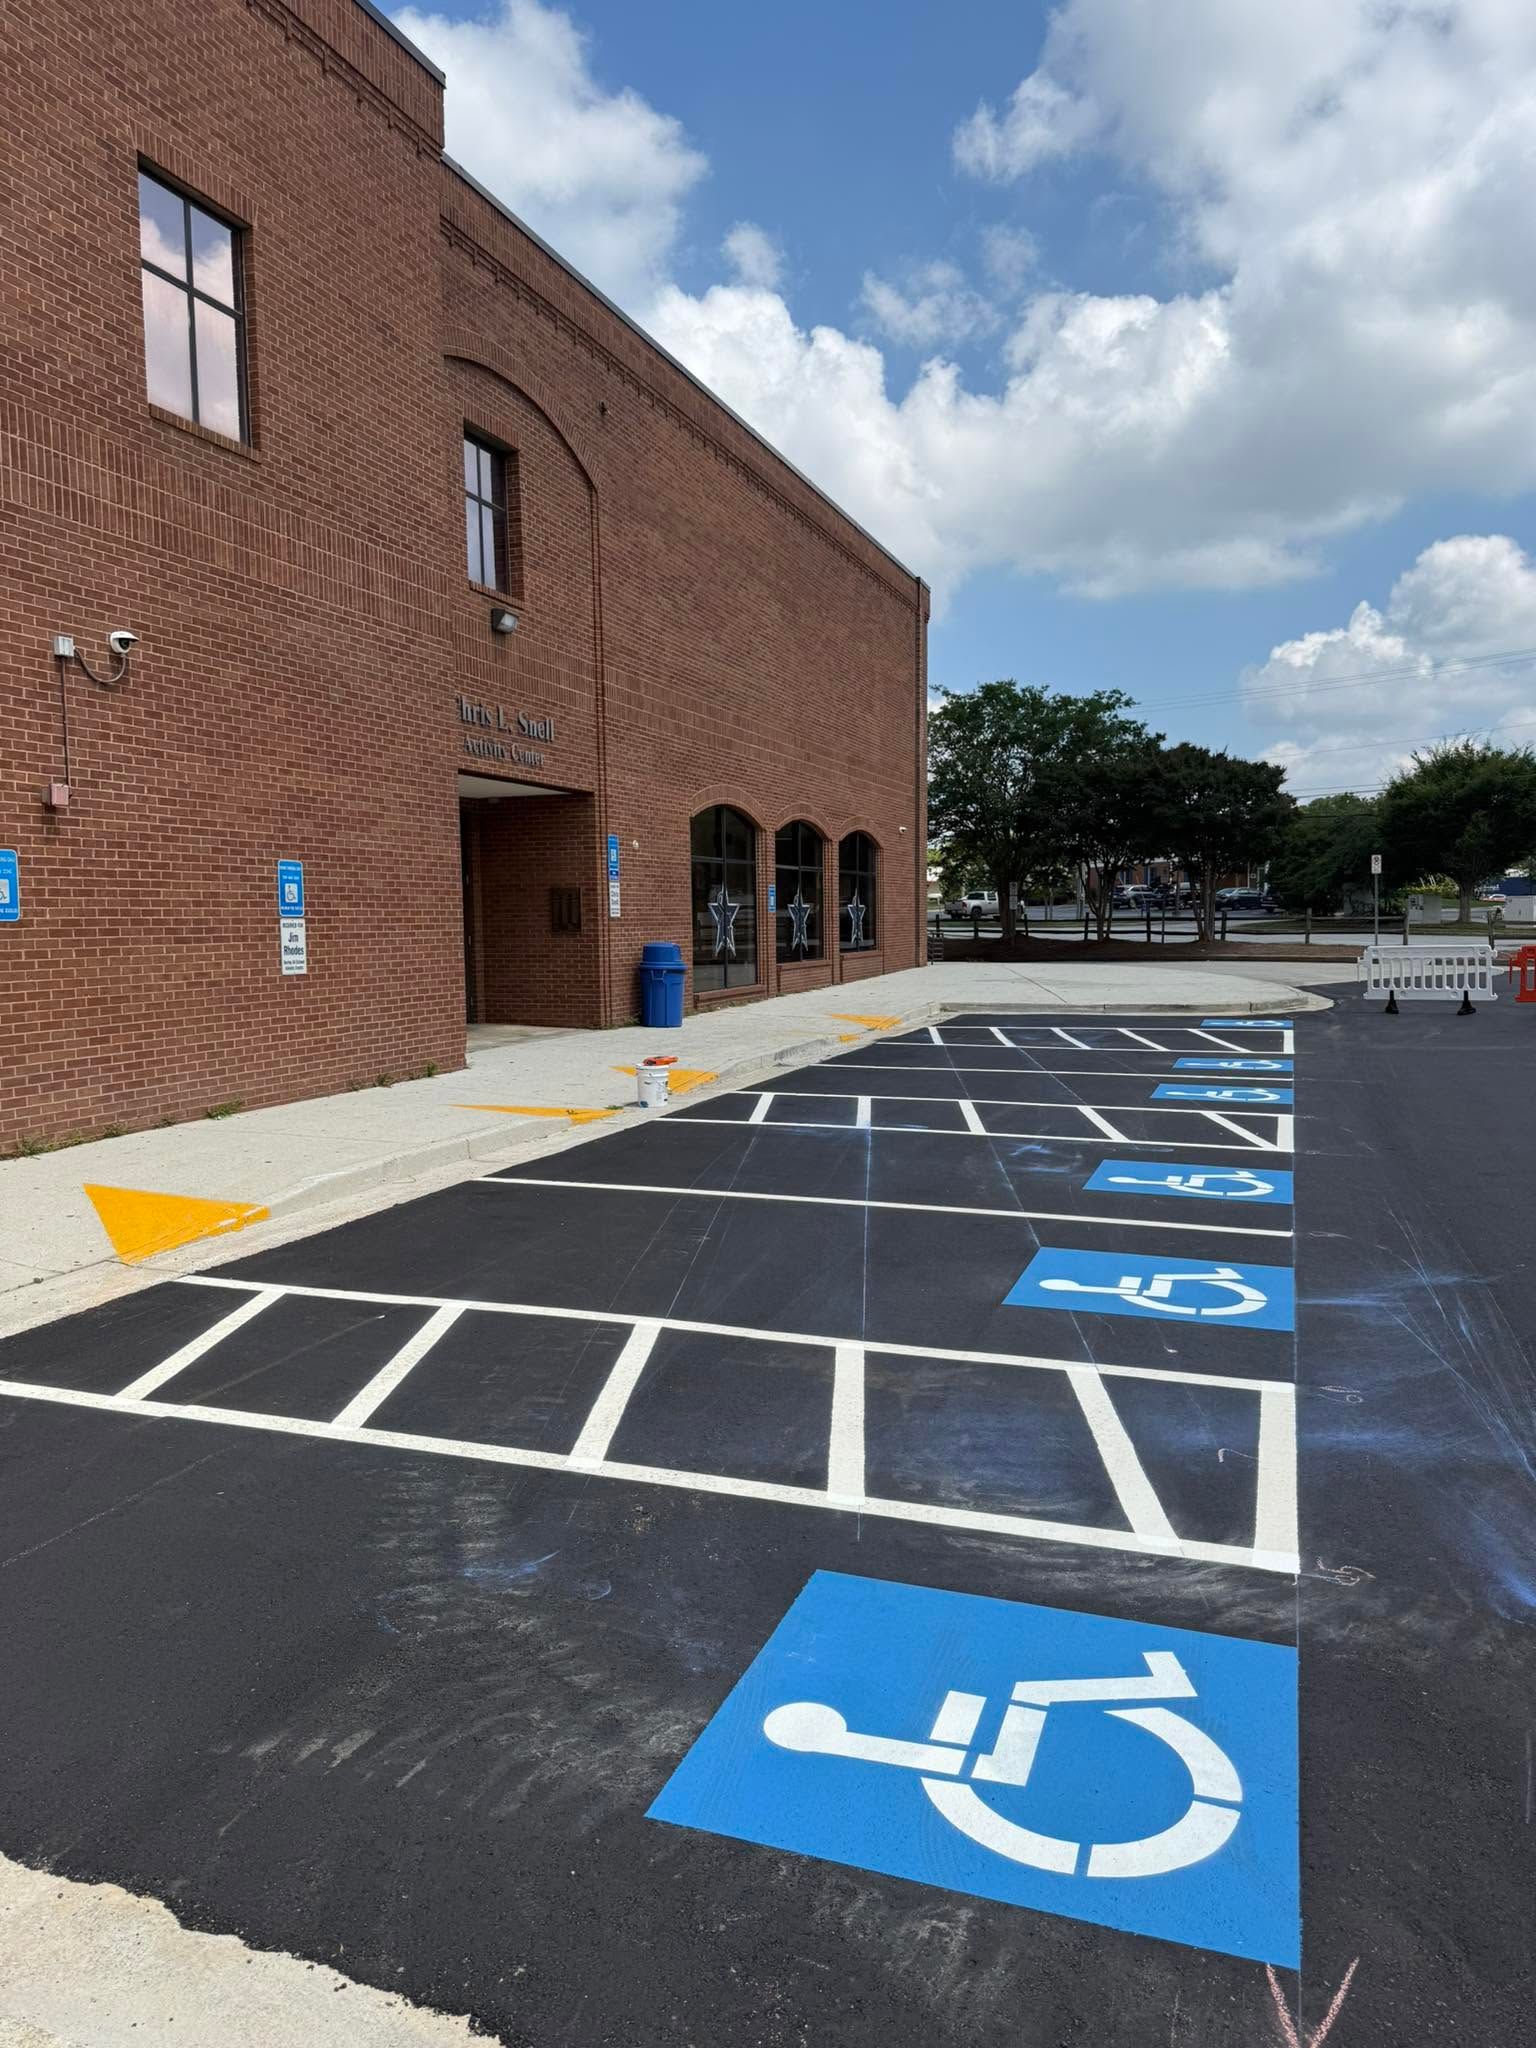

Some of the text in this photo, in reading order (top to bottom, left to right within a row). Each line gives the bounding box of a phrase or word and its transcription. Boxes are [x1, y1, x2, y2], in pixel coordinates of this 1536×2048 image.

[458, 695, 555, 742] hris L. Snell
[288, 932, 299, 943] Jim
[283, 945, 304, 956] Rhodes
